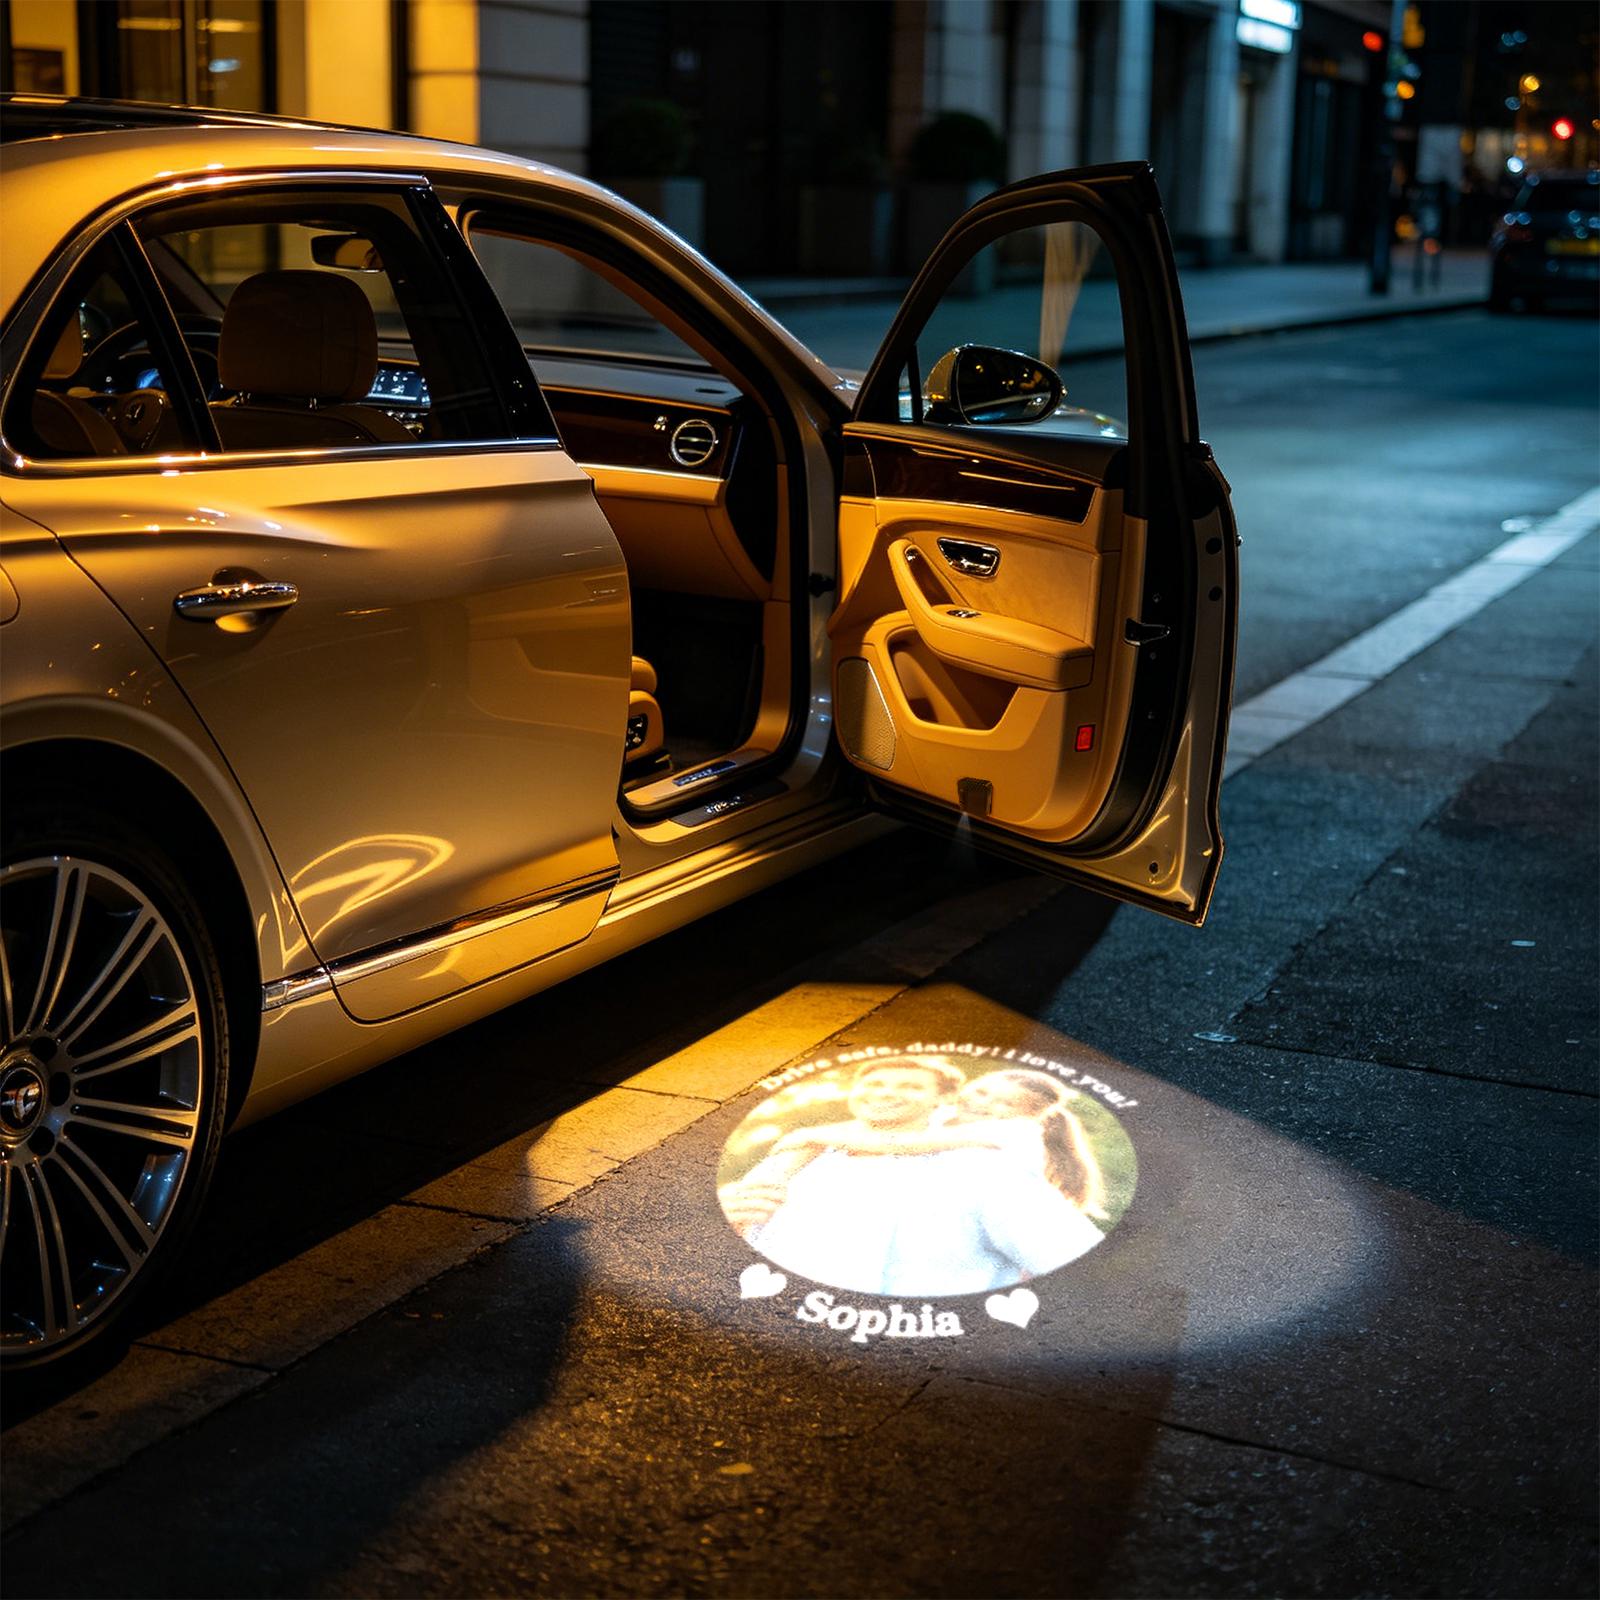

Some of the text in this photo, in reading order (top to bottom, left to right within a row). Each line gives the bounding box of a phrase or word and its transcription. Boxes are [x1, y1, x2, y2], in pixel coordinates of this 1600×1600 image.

[906, 1042, 1000, 1057] daddy!
[1019, 1052, 1076, 1076] love
[1071, 1075, 1138, 1108] you!
[797, 1291, 964, 1343] Sophia
